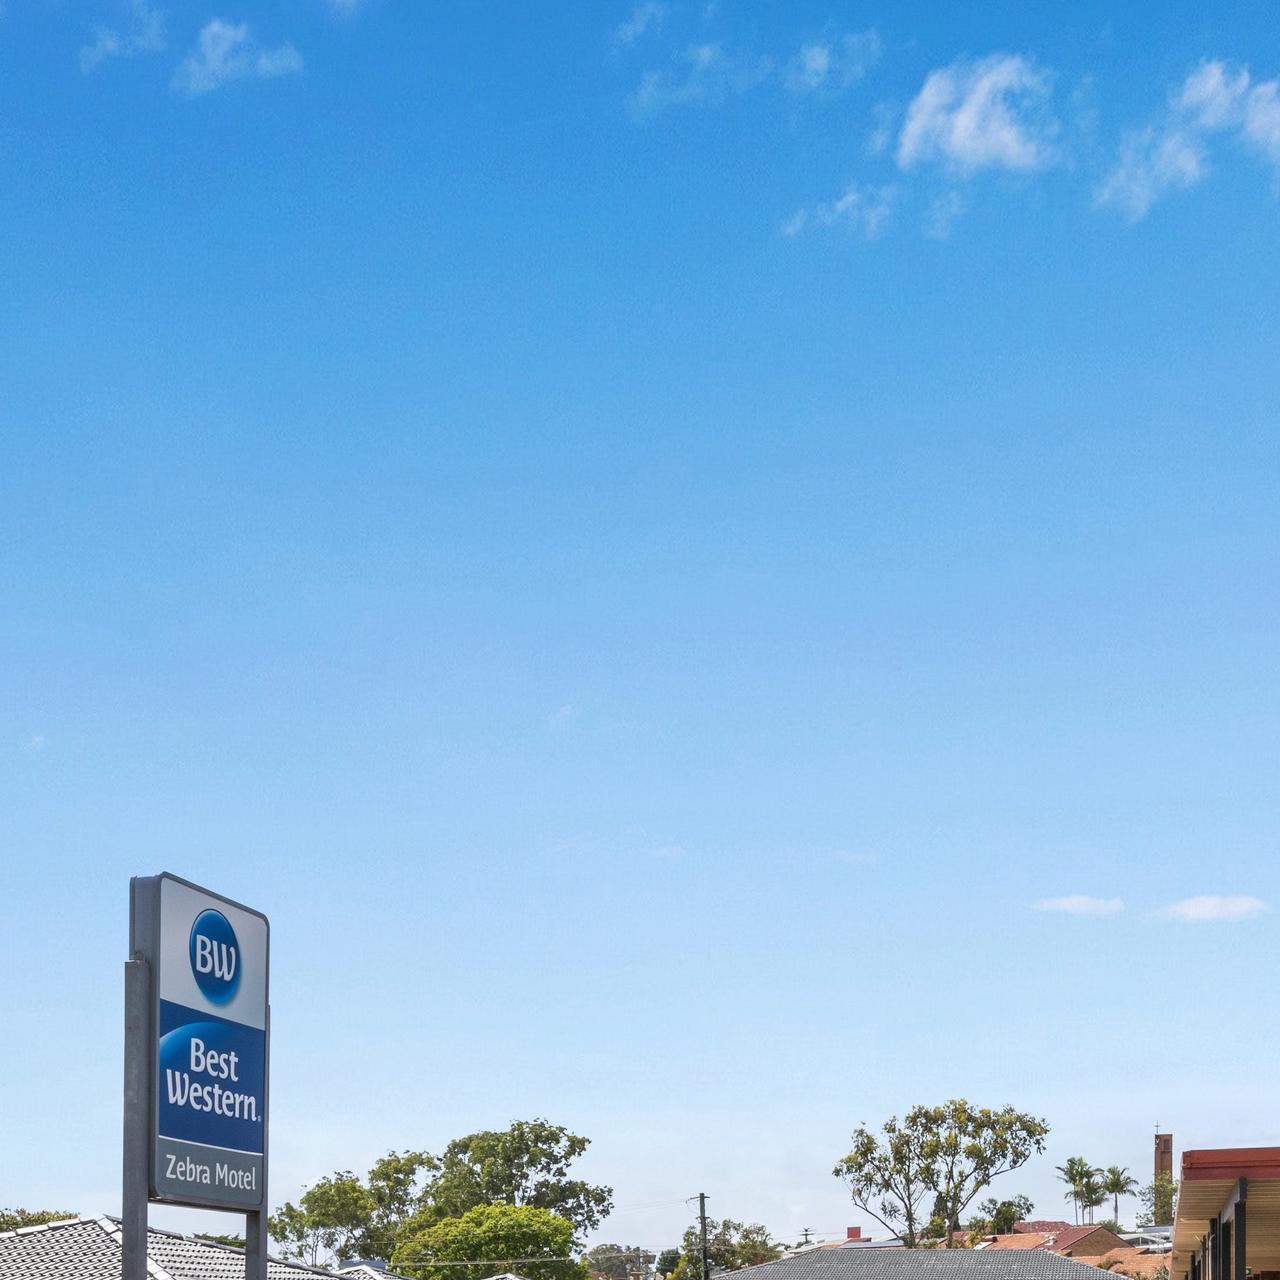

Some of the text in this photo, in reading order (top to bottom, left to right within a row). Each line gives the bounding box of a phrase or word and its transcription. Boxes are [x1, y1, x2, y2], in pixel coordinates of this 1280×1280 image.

[196, 934, 236, 982] BW
[190, 1037, 239, 1082] Best
[166, 1069, 257, 1122] Western
[165, 1154, 256, 1190] Zebra Motel
